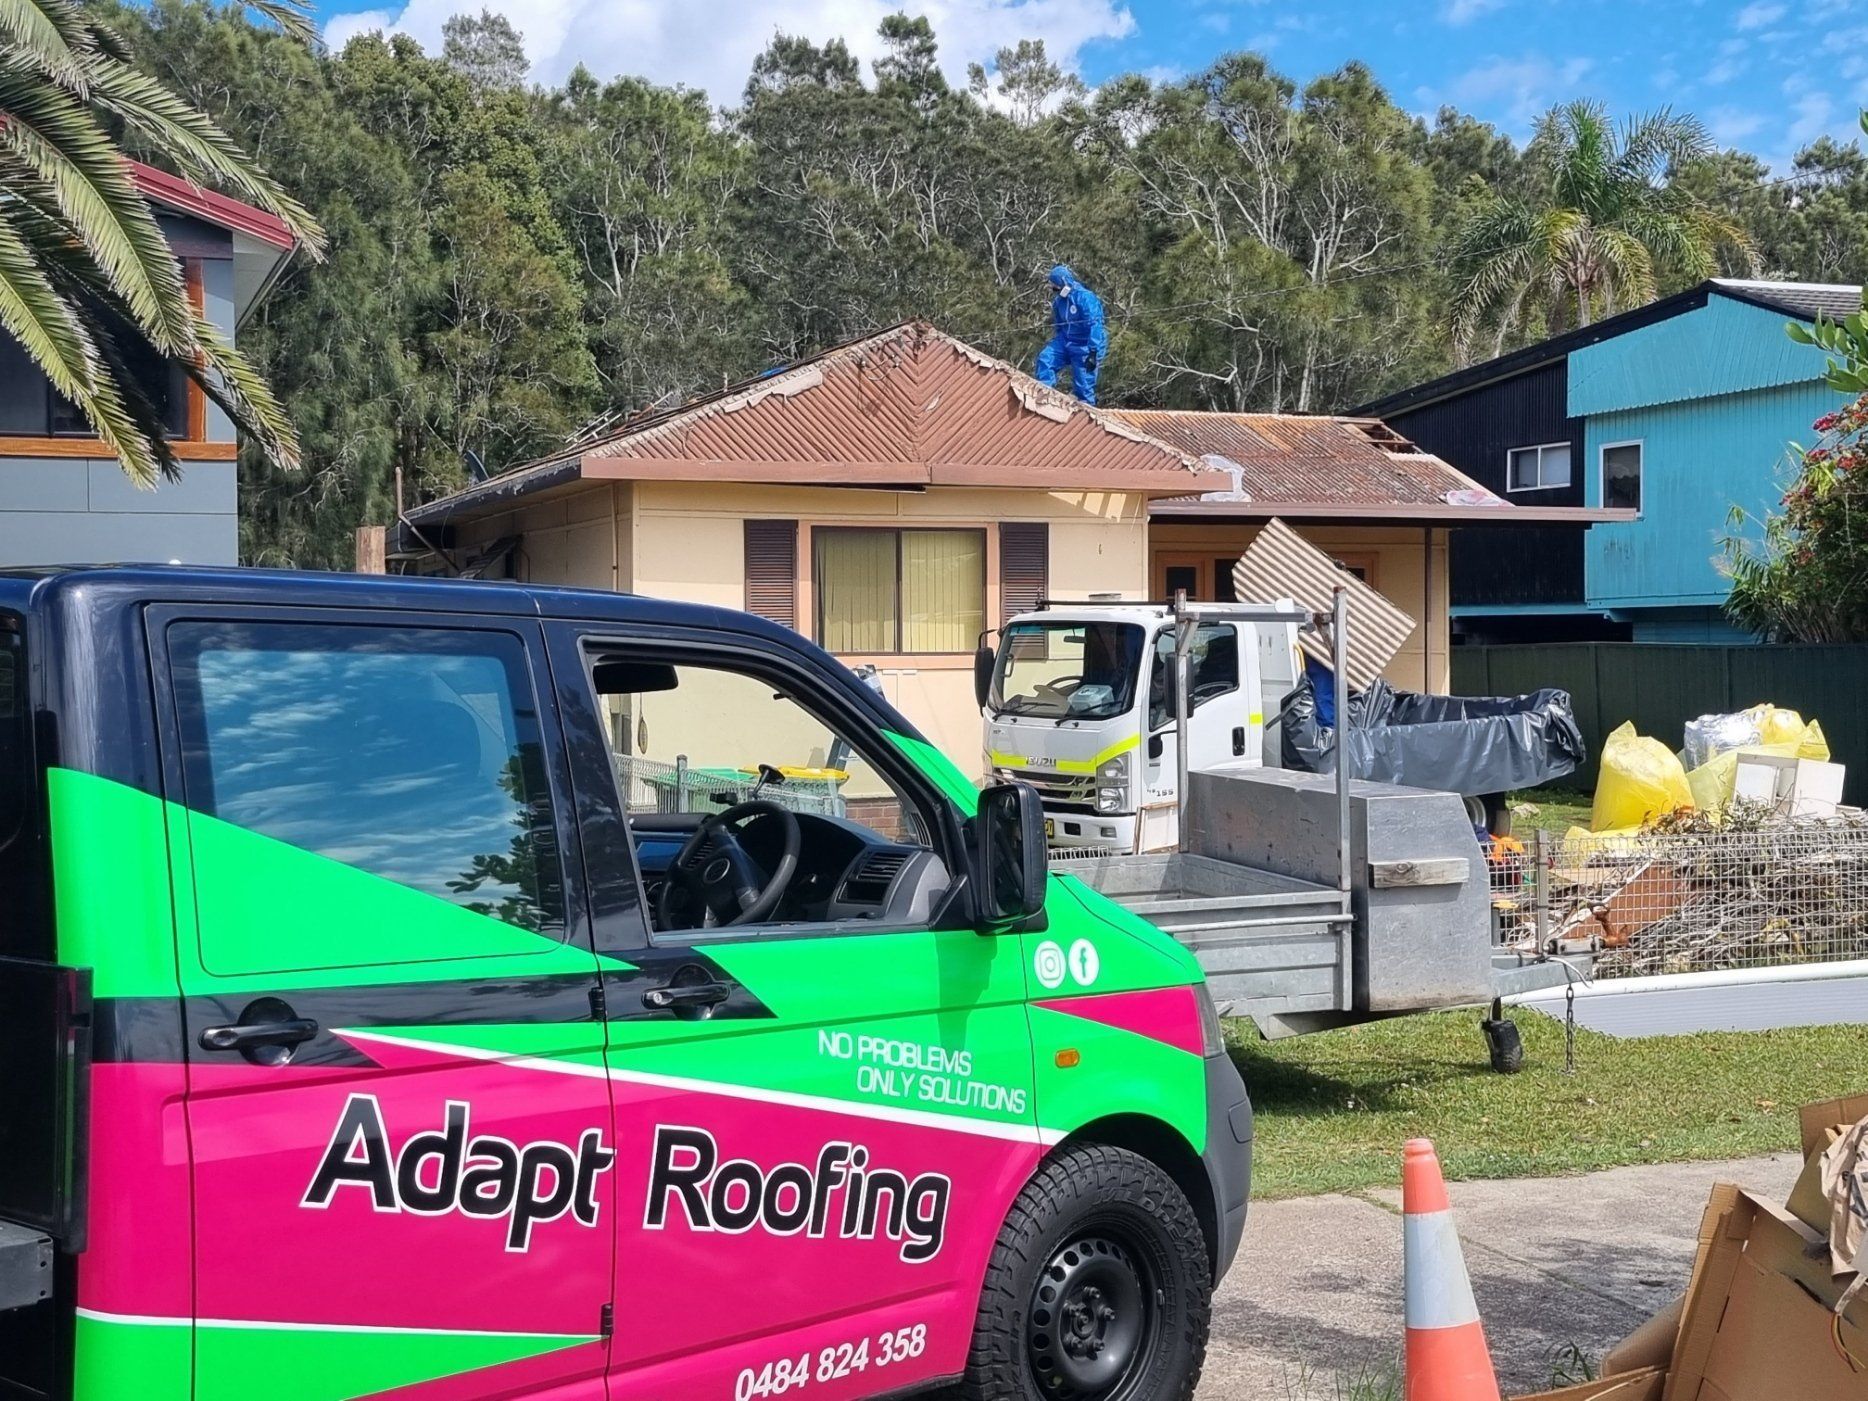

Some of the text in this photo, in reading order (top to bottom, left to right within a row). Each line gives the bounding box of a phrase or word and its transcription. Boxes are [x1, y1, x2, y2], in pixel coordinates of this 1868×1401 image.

[1025, 755, 1057, 768] ISUZU
[817, 1029, 972, 1077] NO PROBLEMS
[856, 1065, 1027, 1114] ONLY SOLUTIONS
[298, 1092, 951, 1264] Adapt Roofing
[735, 1323, 927, 1401] 0484 824 358
